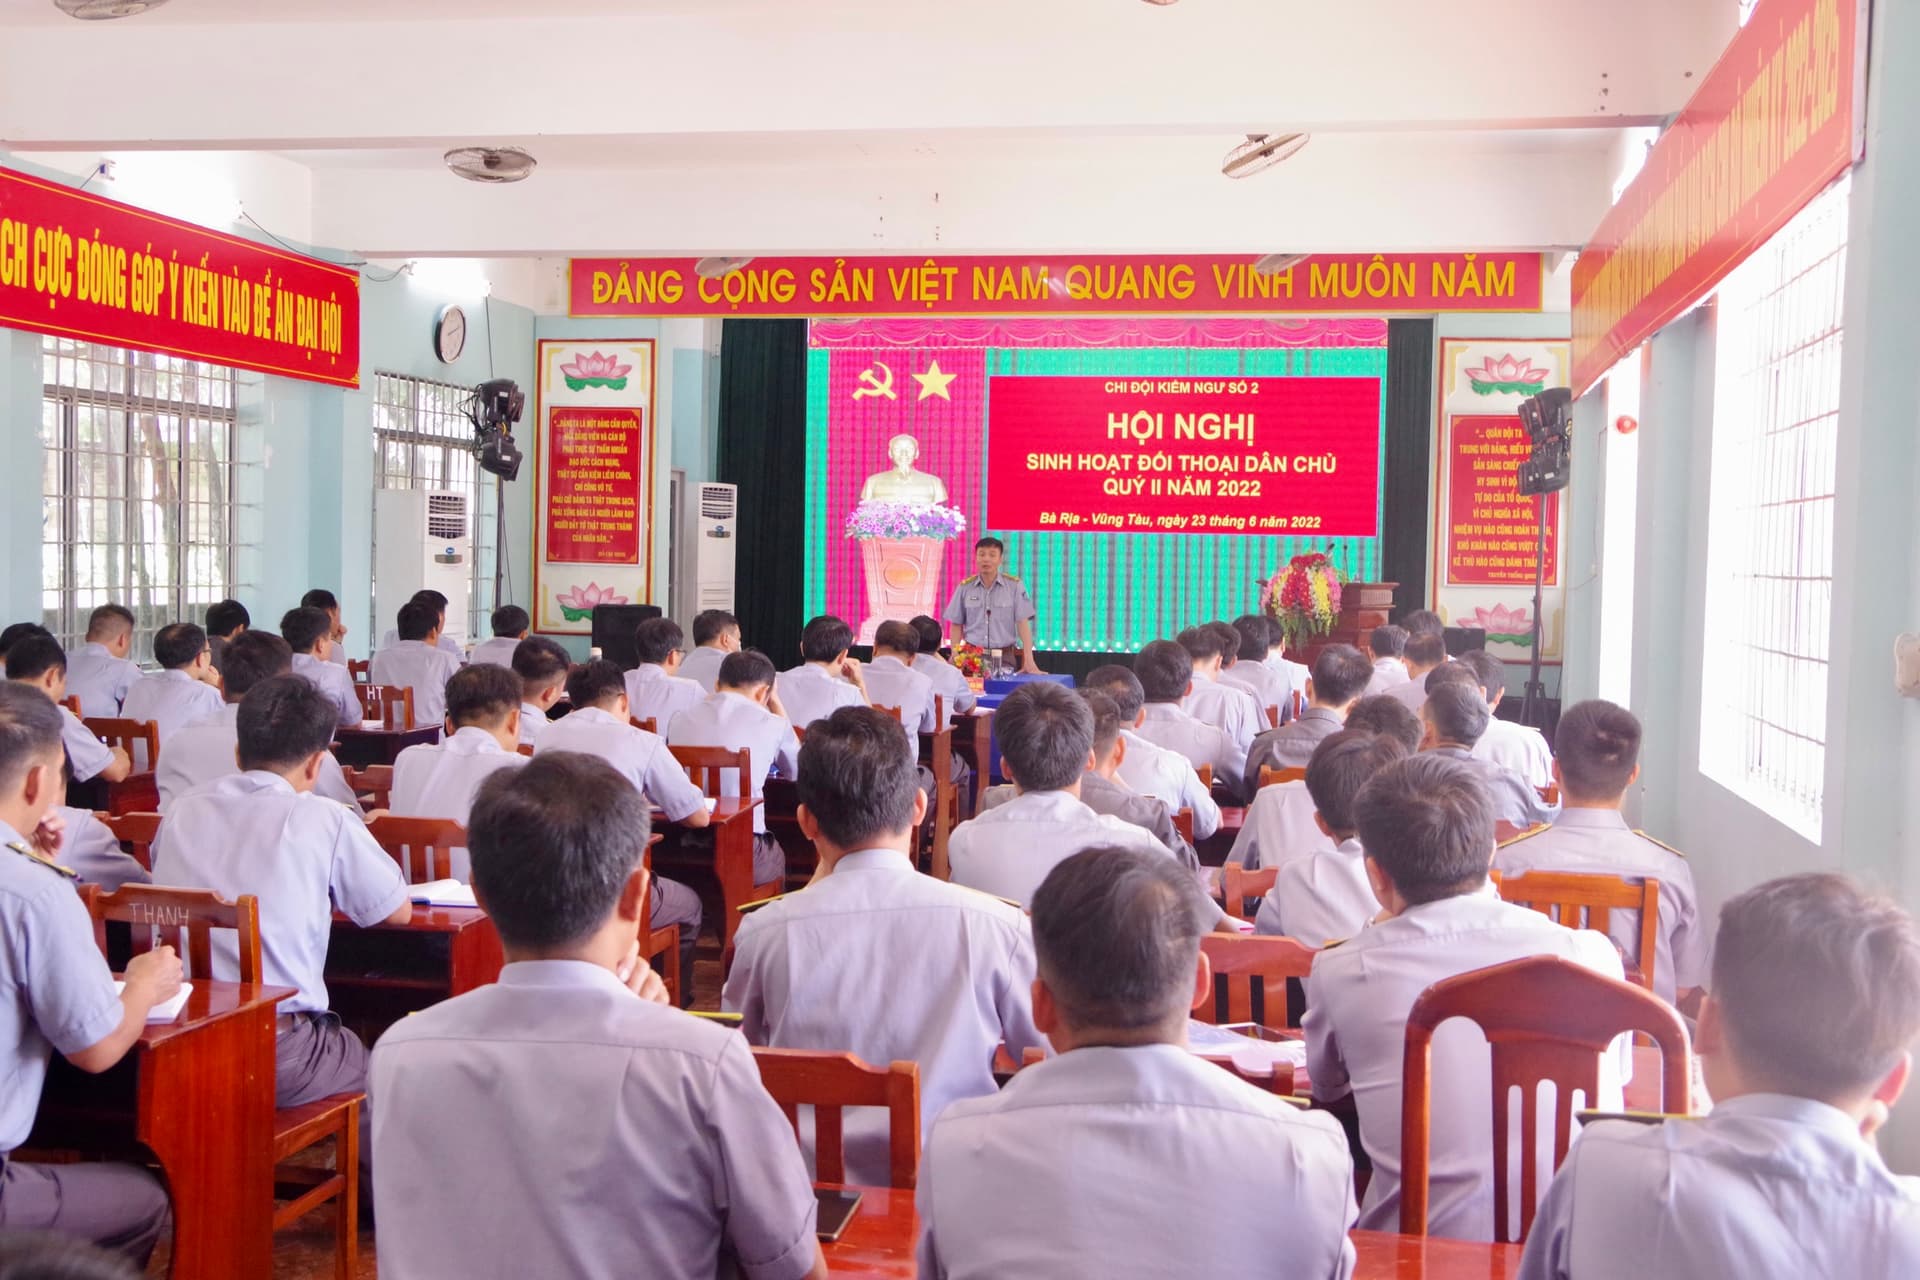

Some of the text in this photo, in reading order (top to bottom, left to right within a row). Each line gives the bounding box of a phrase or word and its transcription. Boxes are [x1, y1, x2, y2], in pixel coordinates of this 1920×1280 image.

[1, 218, 342, 365] CH CỰC ĐÓNG GÓP Ý KIẾN VÀO ĐỀ ÁN ĐẠI HỘI
[592, 262, 684, 304] ĐẢNG
[810, 258, 874, 303] SẢN
[887, 259, 958, 308] VIỆT
[973, 266, 1049, 301] NAM
[1065, 263, 1196, 301] QUANG
[1212, 263, 1293, 299] VINH
[1309, 254, 1415, 298] MUÔN
[1431, 253, 1515, 297] NĂM
[1105, 382, 1129, 394] CHI
[1131, 380, 1156, 397] ĐỘI
[1193, 381, 1226, 394] NGƯ
[1228, 379, 1249, 395] SỐ
[1251, 382, 1259, 395] 2
[1107, 410, 1255, 446] HỘI NGHỊ
[1026, 451, 1336, 476] SINH HOẠT ĐỐI THOẠI DÂN CHỦ
[1103, 475, 1261, 497] QUÝ II NĂM 2022
[1040, 512, 1058, 524] Bà
[1060, 513, 1080, 527] Rịa
[1091, 512, 1124, 527] Vũng
[1126, 512, 1154, 527] Tàu,
[1157, 513, 1187, 529] ngày
[1191, 515, 1207, 526] 23
[1209, 513, 1245, 529] tháng
[1248, 515, 1257, 527] 6
[1259, 514, 1287, 527] năm
[1291, 515, 1322, 528] 2022
[366, 686, 384, 700] HT
